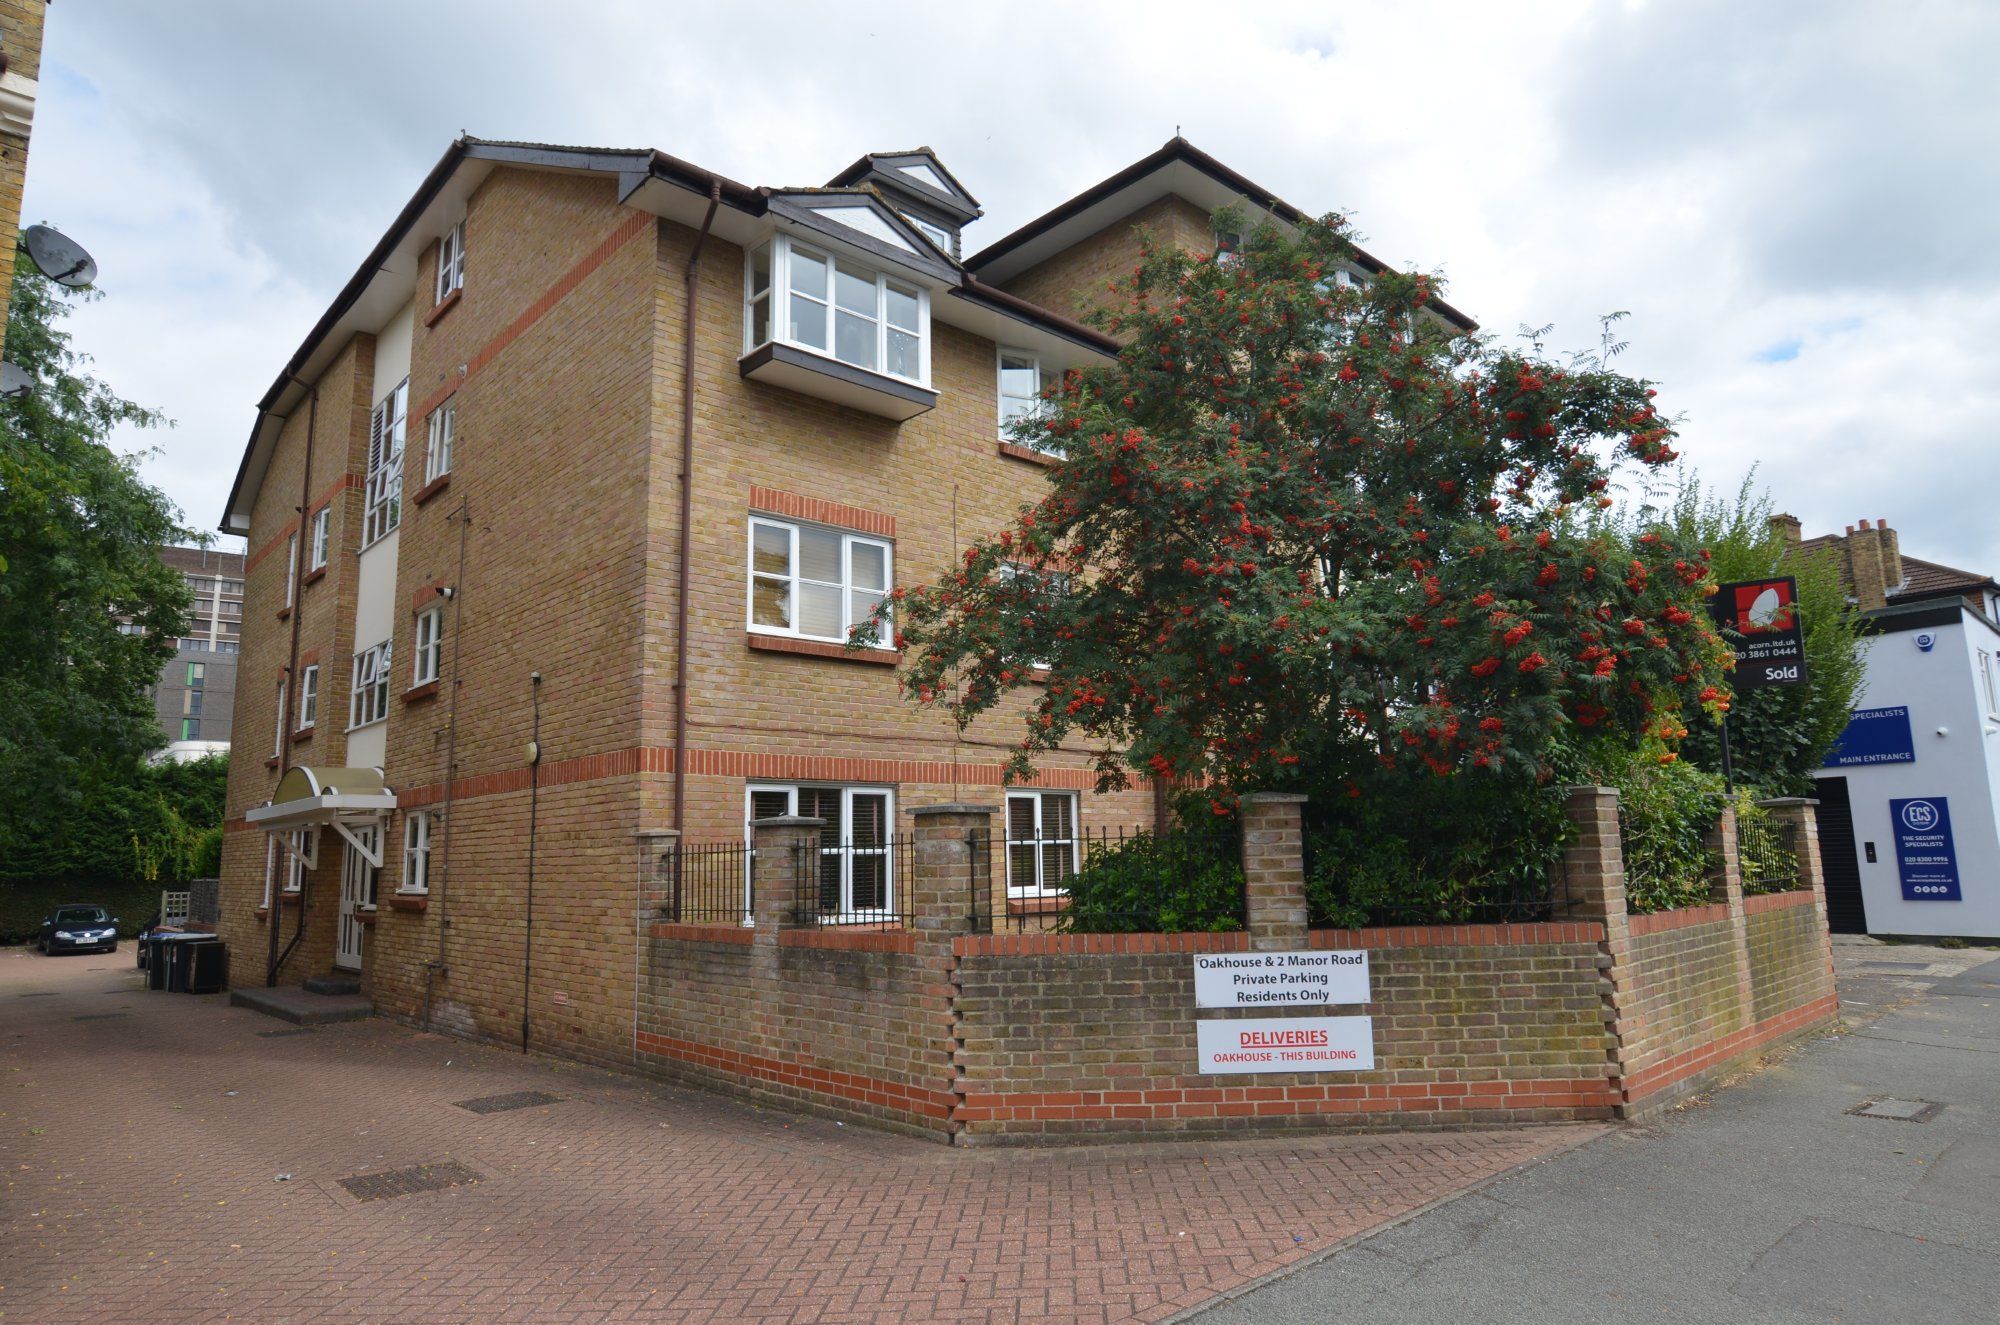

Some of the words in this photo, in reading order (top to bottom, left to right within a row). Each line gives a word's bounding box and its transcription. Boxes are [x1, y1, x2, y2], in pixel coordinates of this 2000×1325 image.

[1748, 639, 1796, 650] acorn.ltd.uk
[1748, 649, 1770, 659] 3861
[1772, 647, 1797, 656] 0444
[1765, 665, 1798, 680] Sold
[1849, 708, 1905, 721] SPECIALISTS
[1840, 755, 1861, 764] MAIN
[1863, 752, 1911, 763] ENTRANCE
[1909, 806, 1931, 822] ECS
[1199, 956, 1262, 969] Oakhouse
[1264, 956, 1274, 967] &
[1277, 956, 1285, 966] 2
[1287, 954, 1329, 966] Manor
[1331, 953, 1363, 965] Road
[1233, 974, 1277, 985] Private
[1280, 972, 1328, 985] Parking
[1237, 990, 1297, 1002] Residents
[1300, 989, 1330, 1002] Only
[1240, 1030, 1328, 1045] DELIVERIES
[1213, 1052, 1272, 1063] OAKHOUSE
[1280, 1051, 1304, 1061] THIS
[1306, 1050, 1356, 1061] BUILDING
